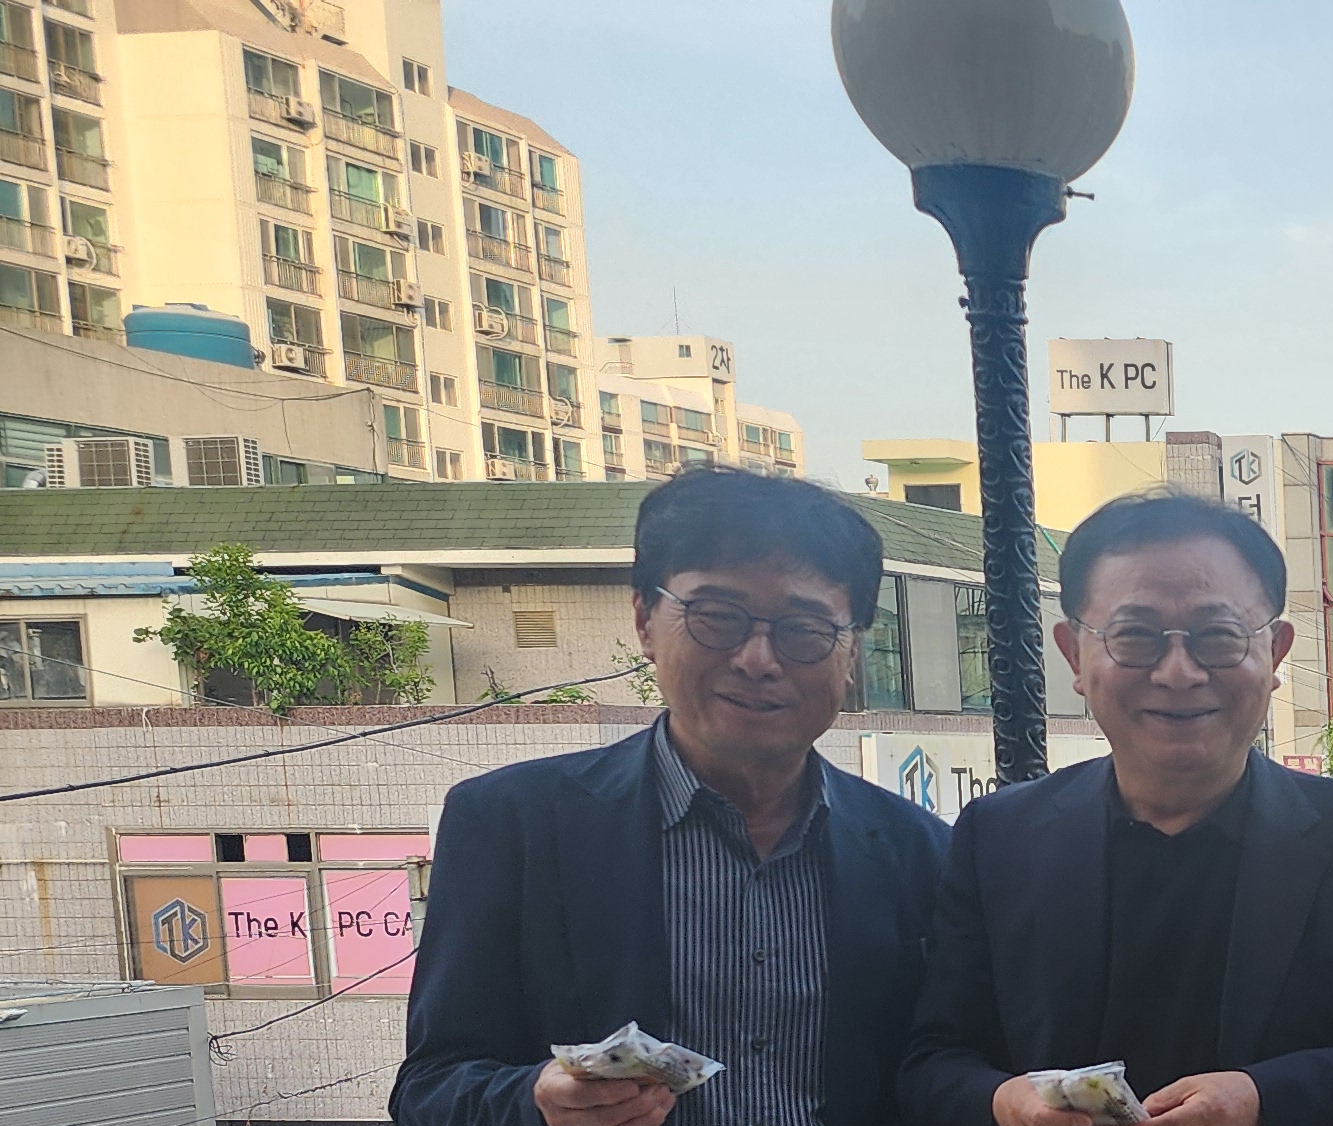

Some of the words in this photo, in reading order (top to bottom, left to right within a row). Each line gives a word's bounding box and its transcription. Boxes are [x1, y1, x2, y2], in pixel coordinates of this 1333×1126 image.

[710, 344, 731, 374] 2차
[1056, 369, 1092, 389] The
[1099, 362, 1117, 389] K
[1123, 362, 1157, 389] PC
[228, 911, 279, 939] The
[289, 911, 307, 938] K
[338, 911, 373, 938] PC
